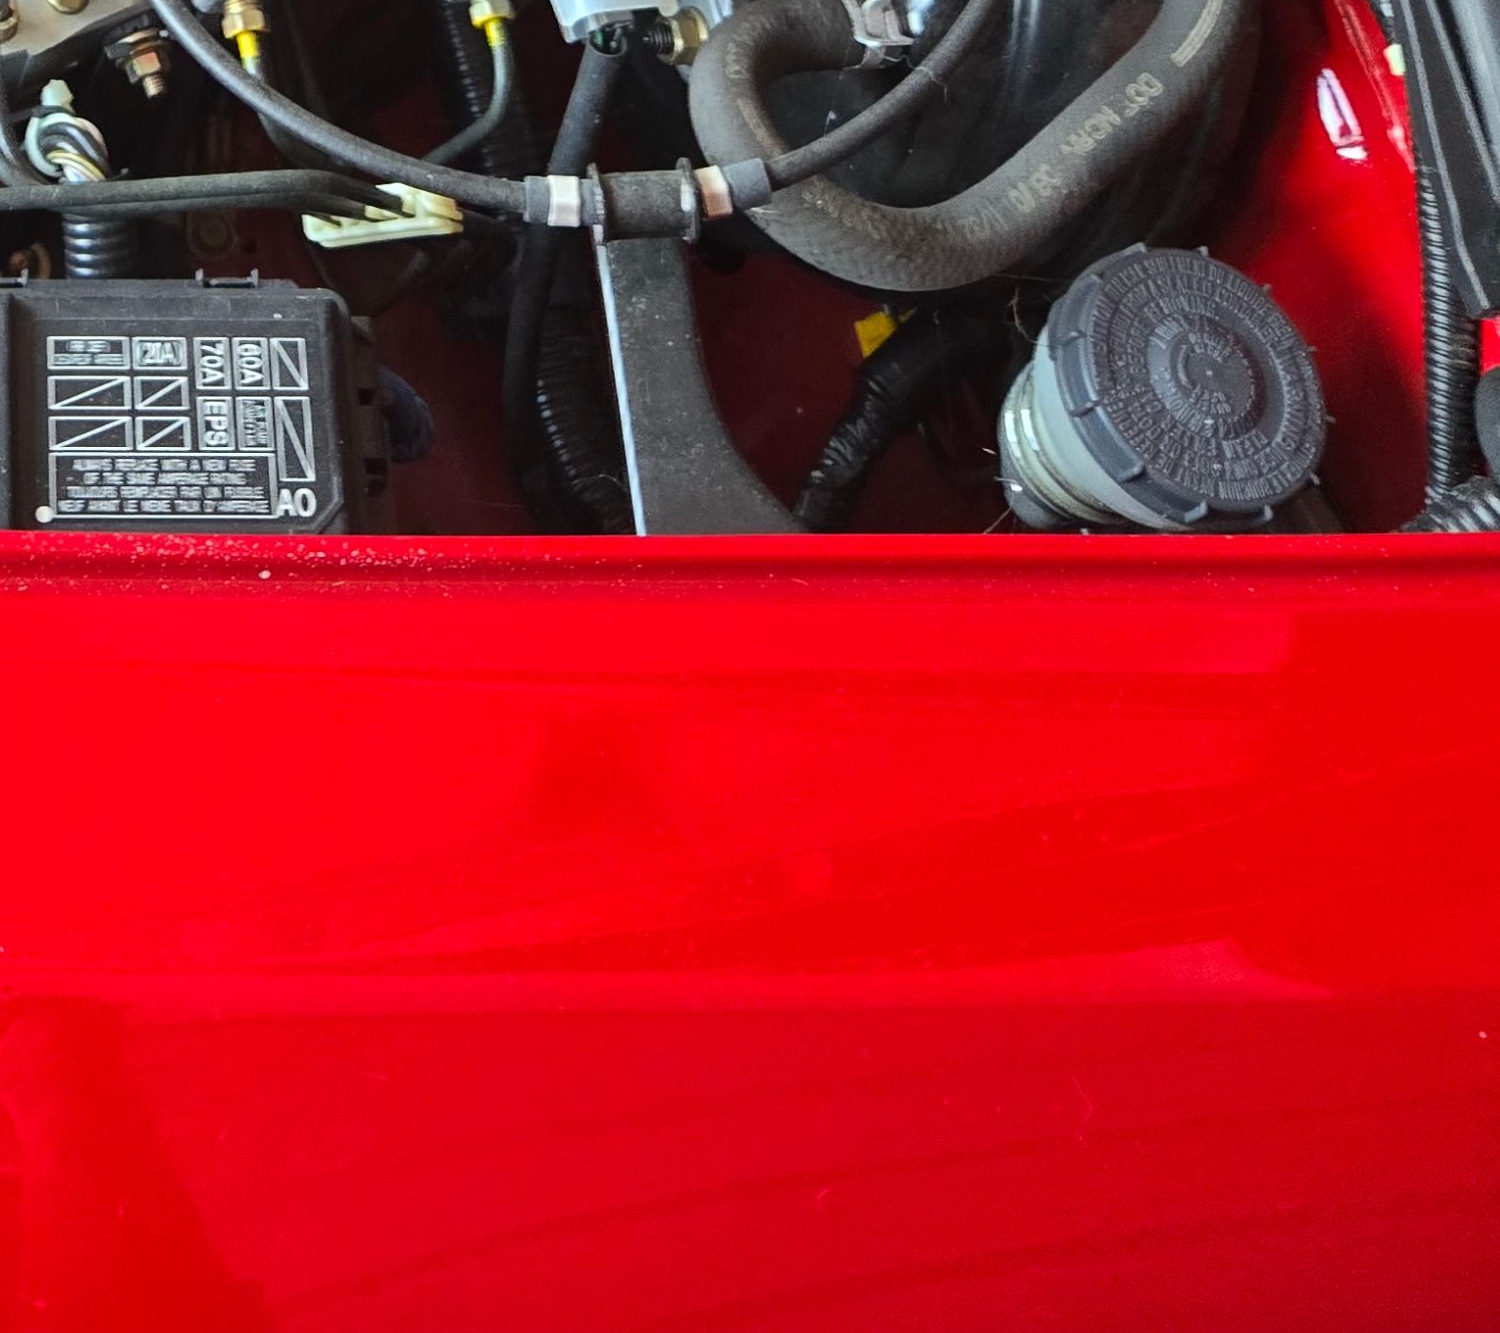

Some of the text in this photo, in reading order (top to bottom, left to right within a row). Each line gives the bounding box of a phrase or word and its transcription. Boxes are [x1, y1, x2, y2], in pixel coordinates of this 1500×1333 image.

[1224, 272, 1274, 317] LIQUIDE
[200, 342, 225, 383] 70A
[205, 402, 228, 446] EPS
